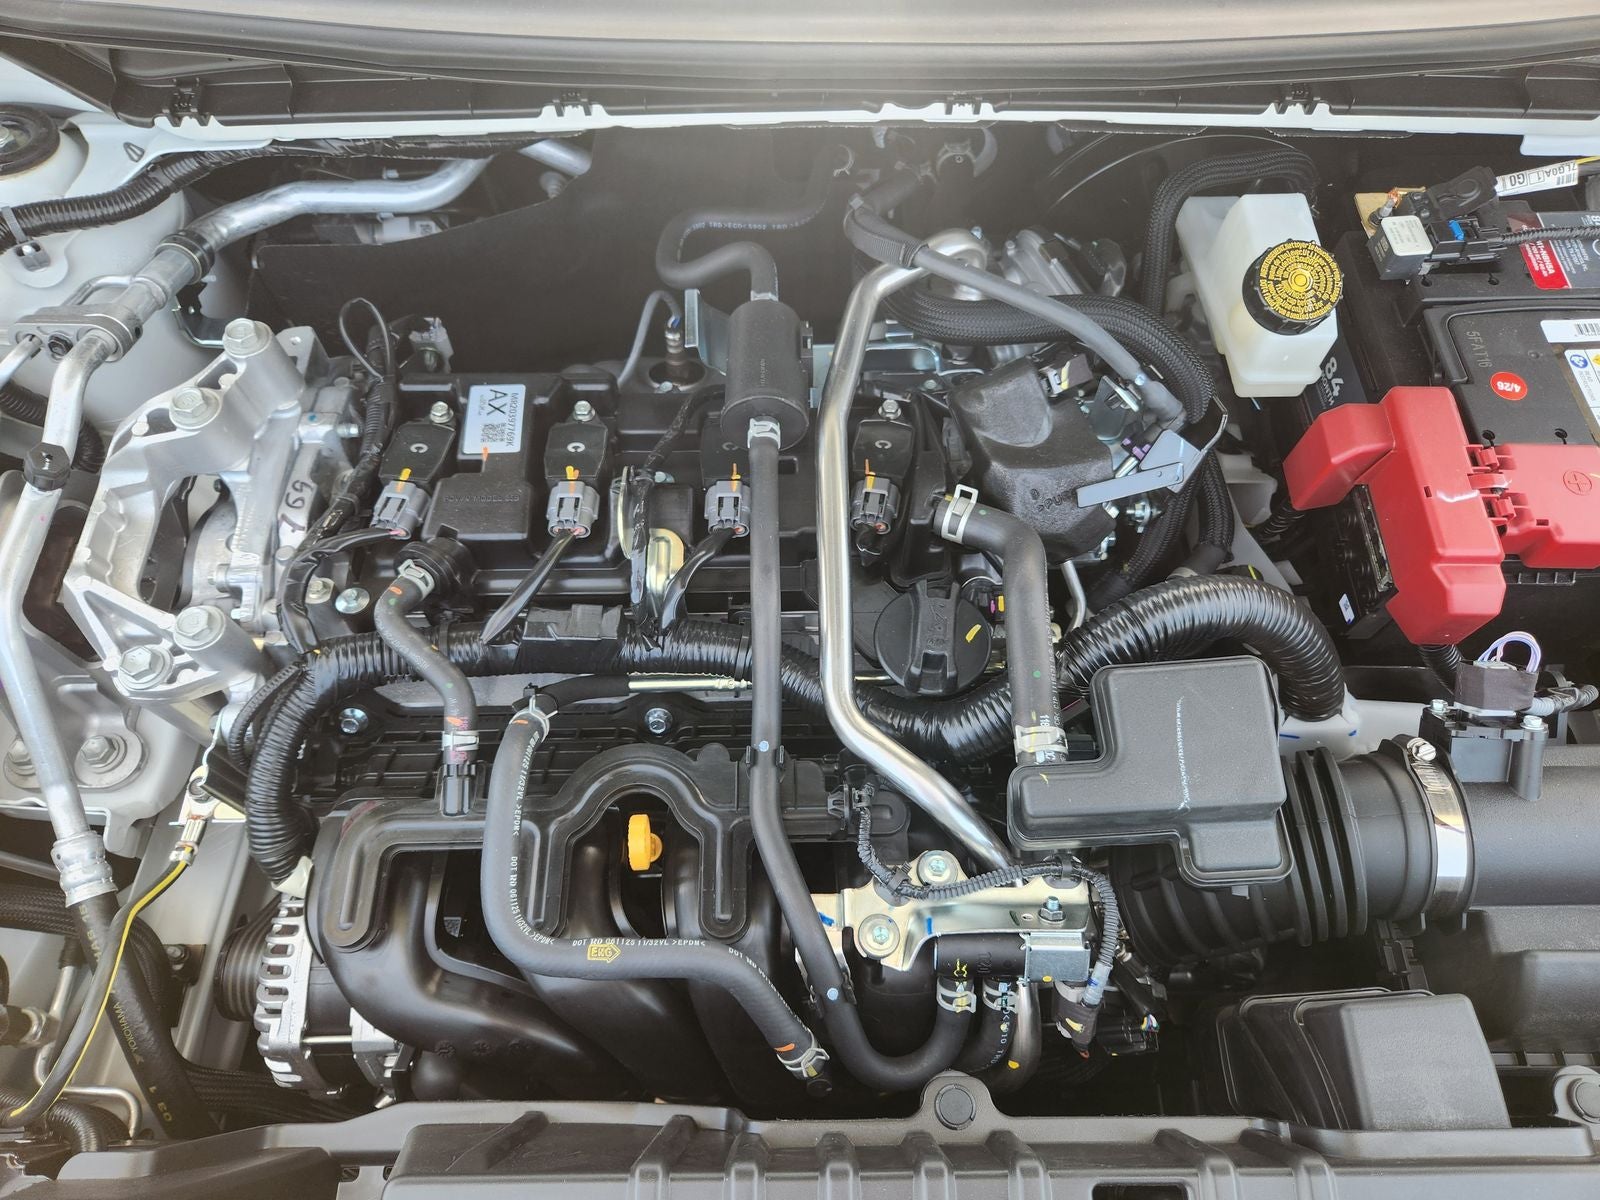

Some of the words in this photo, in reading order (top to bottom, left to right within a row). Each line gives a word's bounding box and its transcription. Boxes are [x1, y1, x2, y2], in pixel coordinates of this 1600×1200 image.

[1325, 356, 1344, 397] 84
[1496, 381, 1521, 393] 4/26
[487, 389, 508, 416] AX
[113, 1002, 138, 1052] YOKOHAMA
